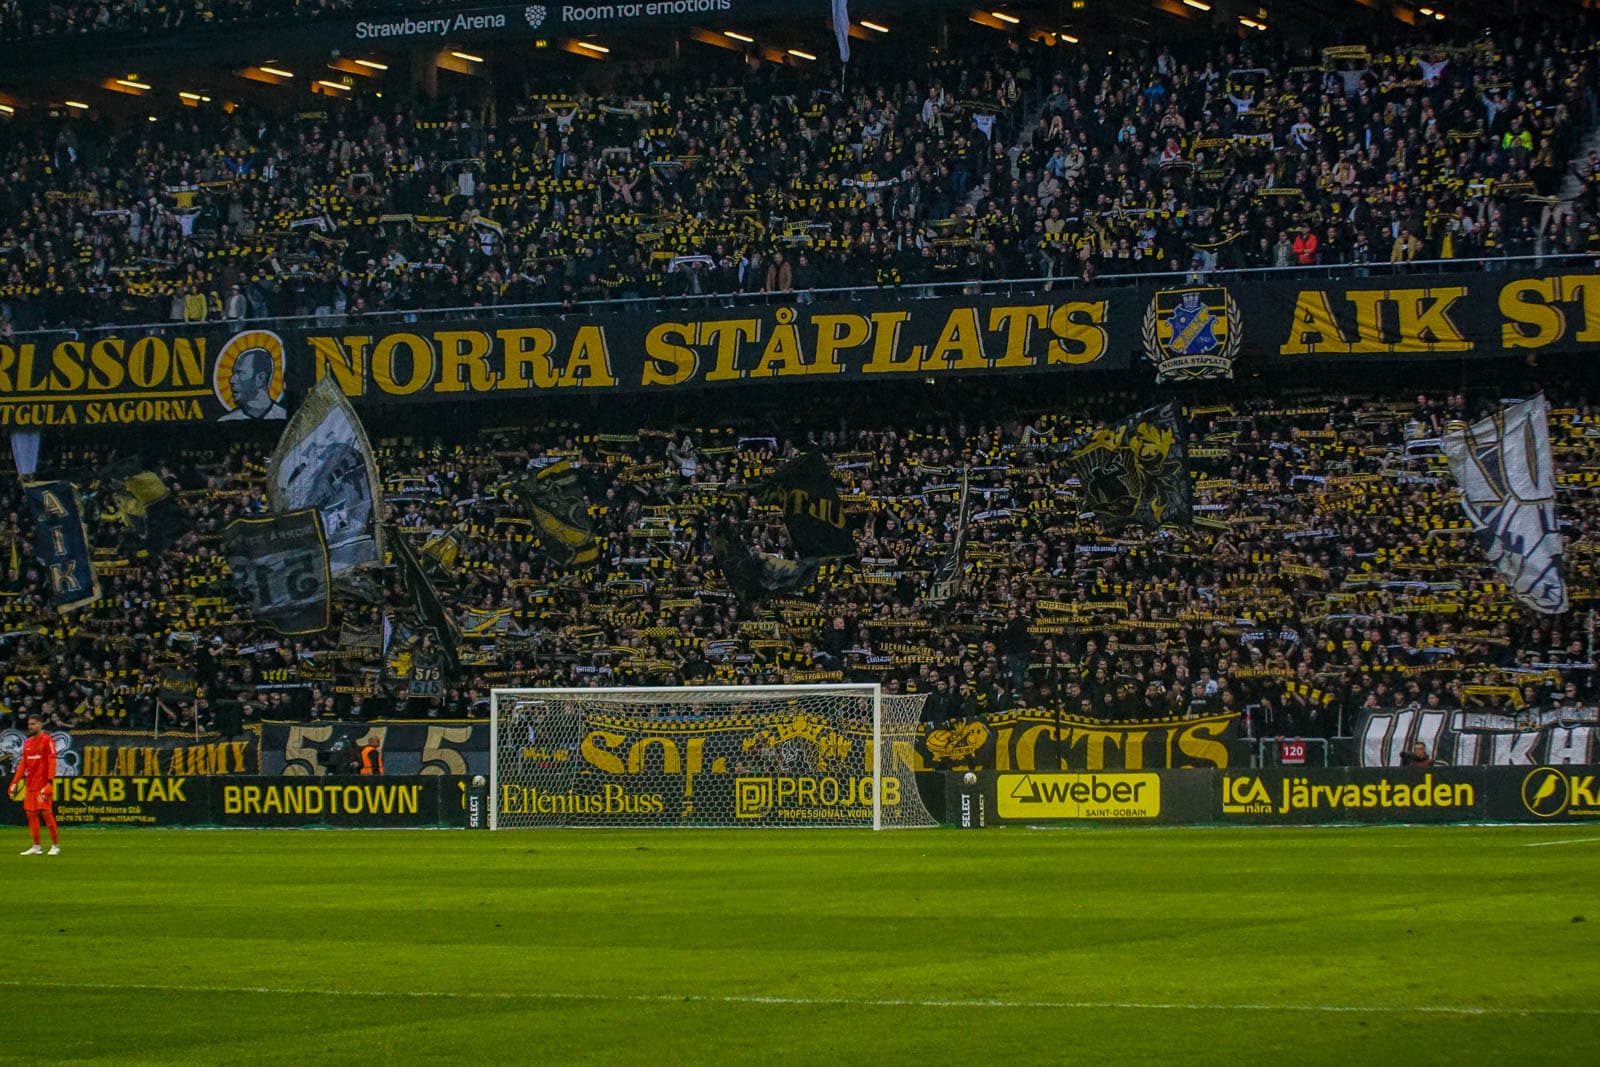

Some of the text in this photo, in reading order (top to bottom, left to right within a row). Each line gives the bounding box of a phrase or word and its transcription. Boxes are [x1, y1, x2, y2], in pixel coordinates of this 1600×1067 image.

[355, 11, 506, 39] Strawberry Arena
[562, 2, 615, 22] Room
[649, 0, 732, 16] emotions
[1280, 286, 1475, 356] AIK
[306, 299, 1109, 398] NORRA STÅPLATS
[85, 399, 204, 425] SAGORNA
[83, 741, 249, 776] BLACK ARMY
[1282, 745, 1304, 757] 120
[132, 778, 187, 802] TAK
[223, 785, 418, 814] BRANDTOWN
[1041, 776, 1146, 803] weber
[1223, 776, 1272, 804] ICA
[1279, 773, 1474, 814] Järvastaden
[470, 796, 478, 828] SELECT
[777, 809, 846, 818] PROFESSIONAL
[961, 793, 971, 828] SELECT
[1085, 808, 1147, 817] SAINT-GOBAIN
